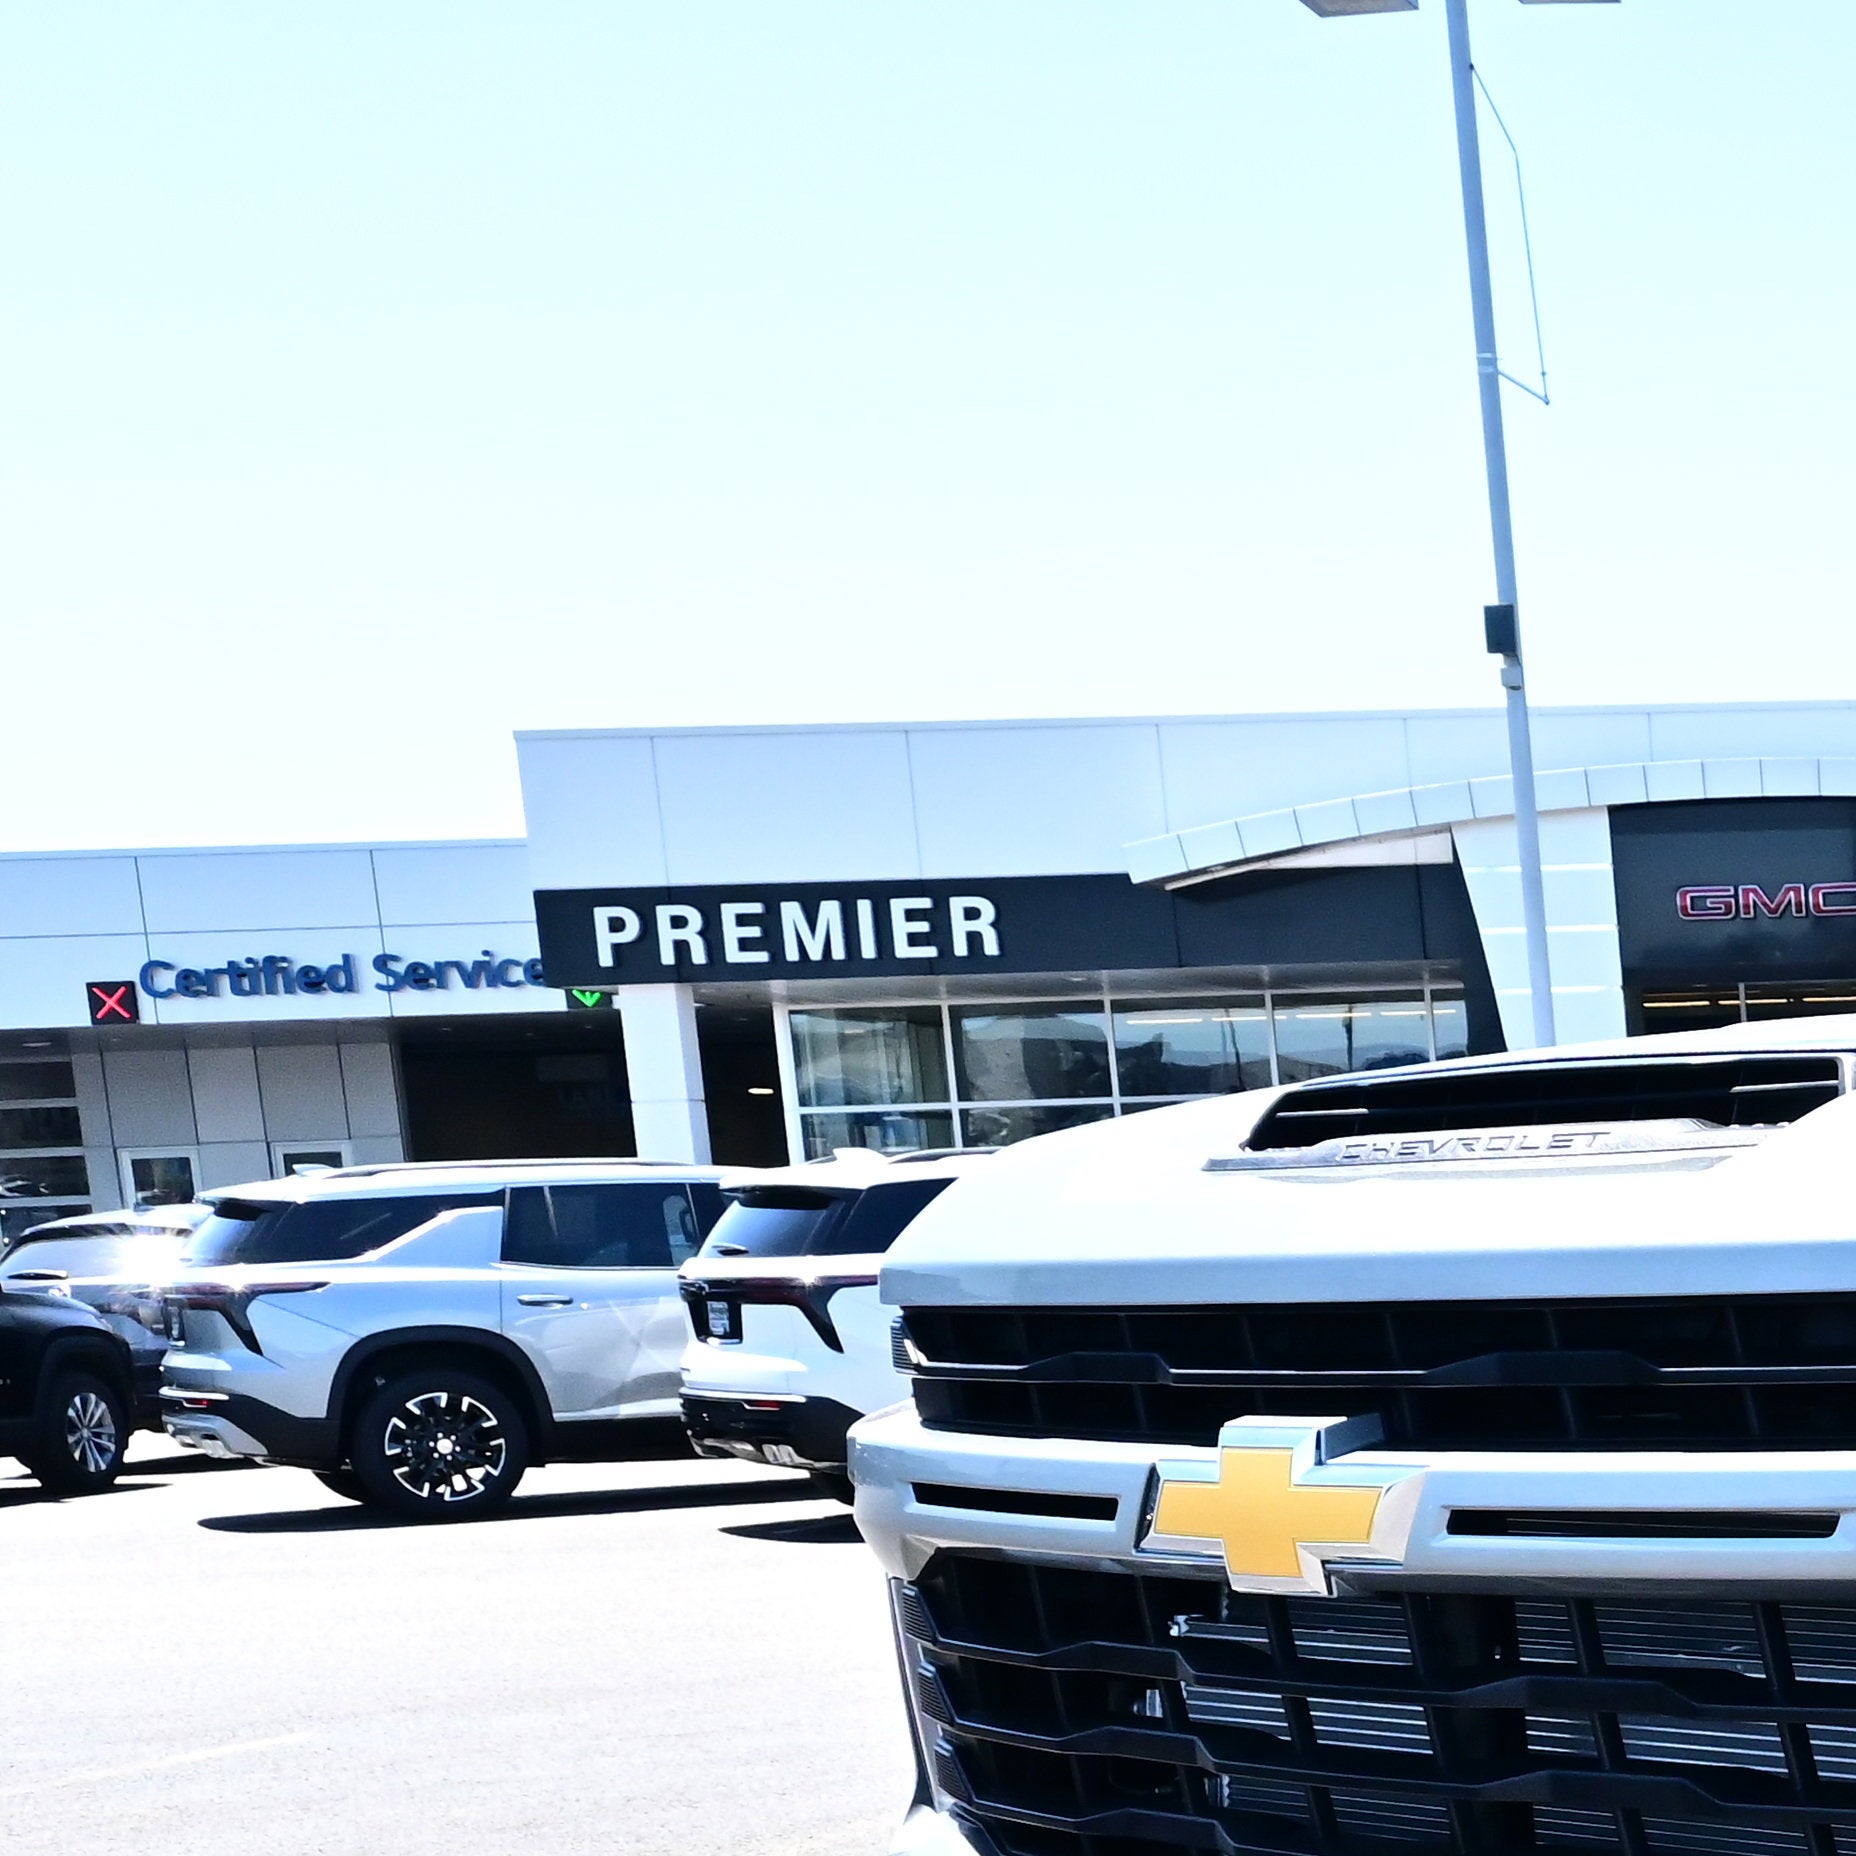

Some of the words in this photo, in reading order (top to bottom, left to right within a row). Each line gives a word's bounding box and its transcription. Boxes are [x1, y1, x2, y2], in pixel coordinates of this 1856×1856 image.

[593, 895, 1001, 968] PREMIER
[140, 953, 358, 999] Certified
[372, 950, 546, 992] Service
[1336, 1131, 1611, 1161] CHEVROLET
